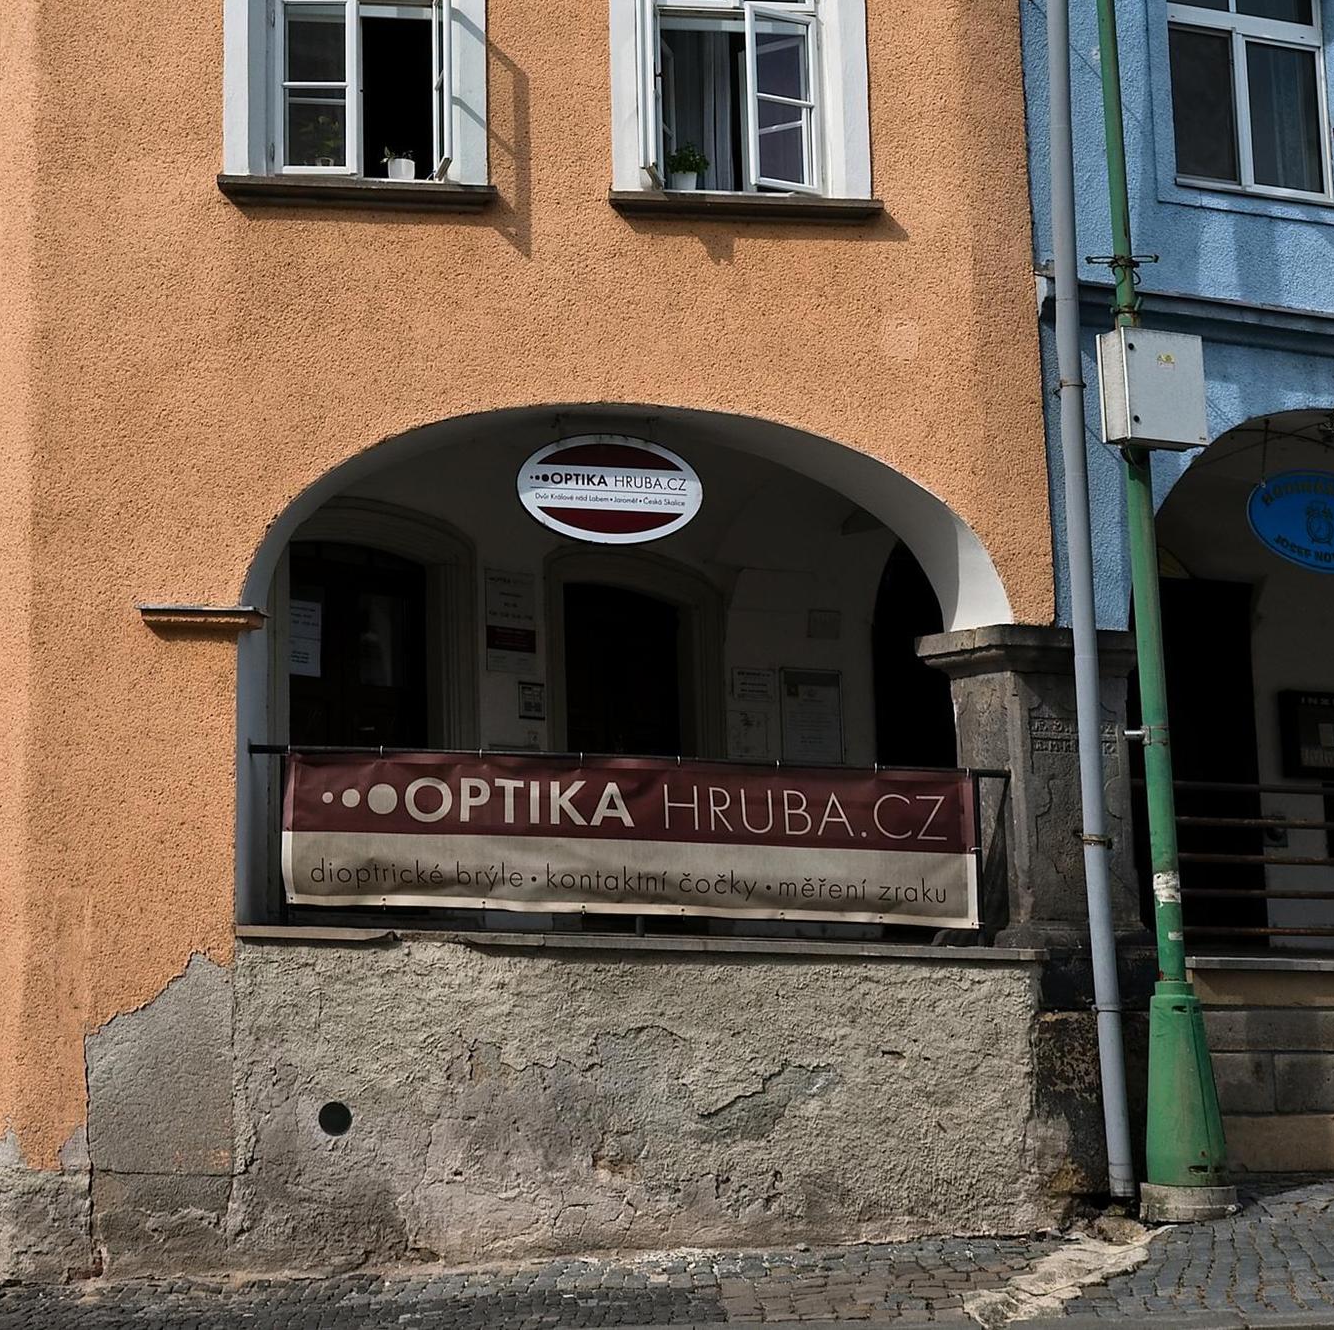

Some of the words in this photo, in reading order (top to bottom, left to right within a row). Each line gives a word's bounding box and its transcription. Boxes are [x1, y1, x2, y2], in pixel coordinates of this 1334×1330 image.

[551, 472, 608, 487] OPTIKA
[614, 475, 686, 491] HRUBA.CZ
[664, 498, 685, 507] Skalice
[1274, 533, 1312, 559] JOSEF
[404, 777, 635, 828] OPTIKA
[663, 783, 948, 841] HRUBA.CZ
[310, 857, 444, 889] dioptrické
[457, 860, 524, 892] brýle
[546, 863, 668, 893] kontaktní
[678, 870, 757, 901] čočky
[778, 876, 868, 901] měření
[877, 878, 947, 904] zraku
